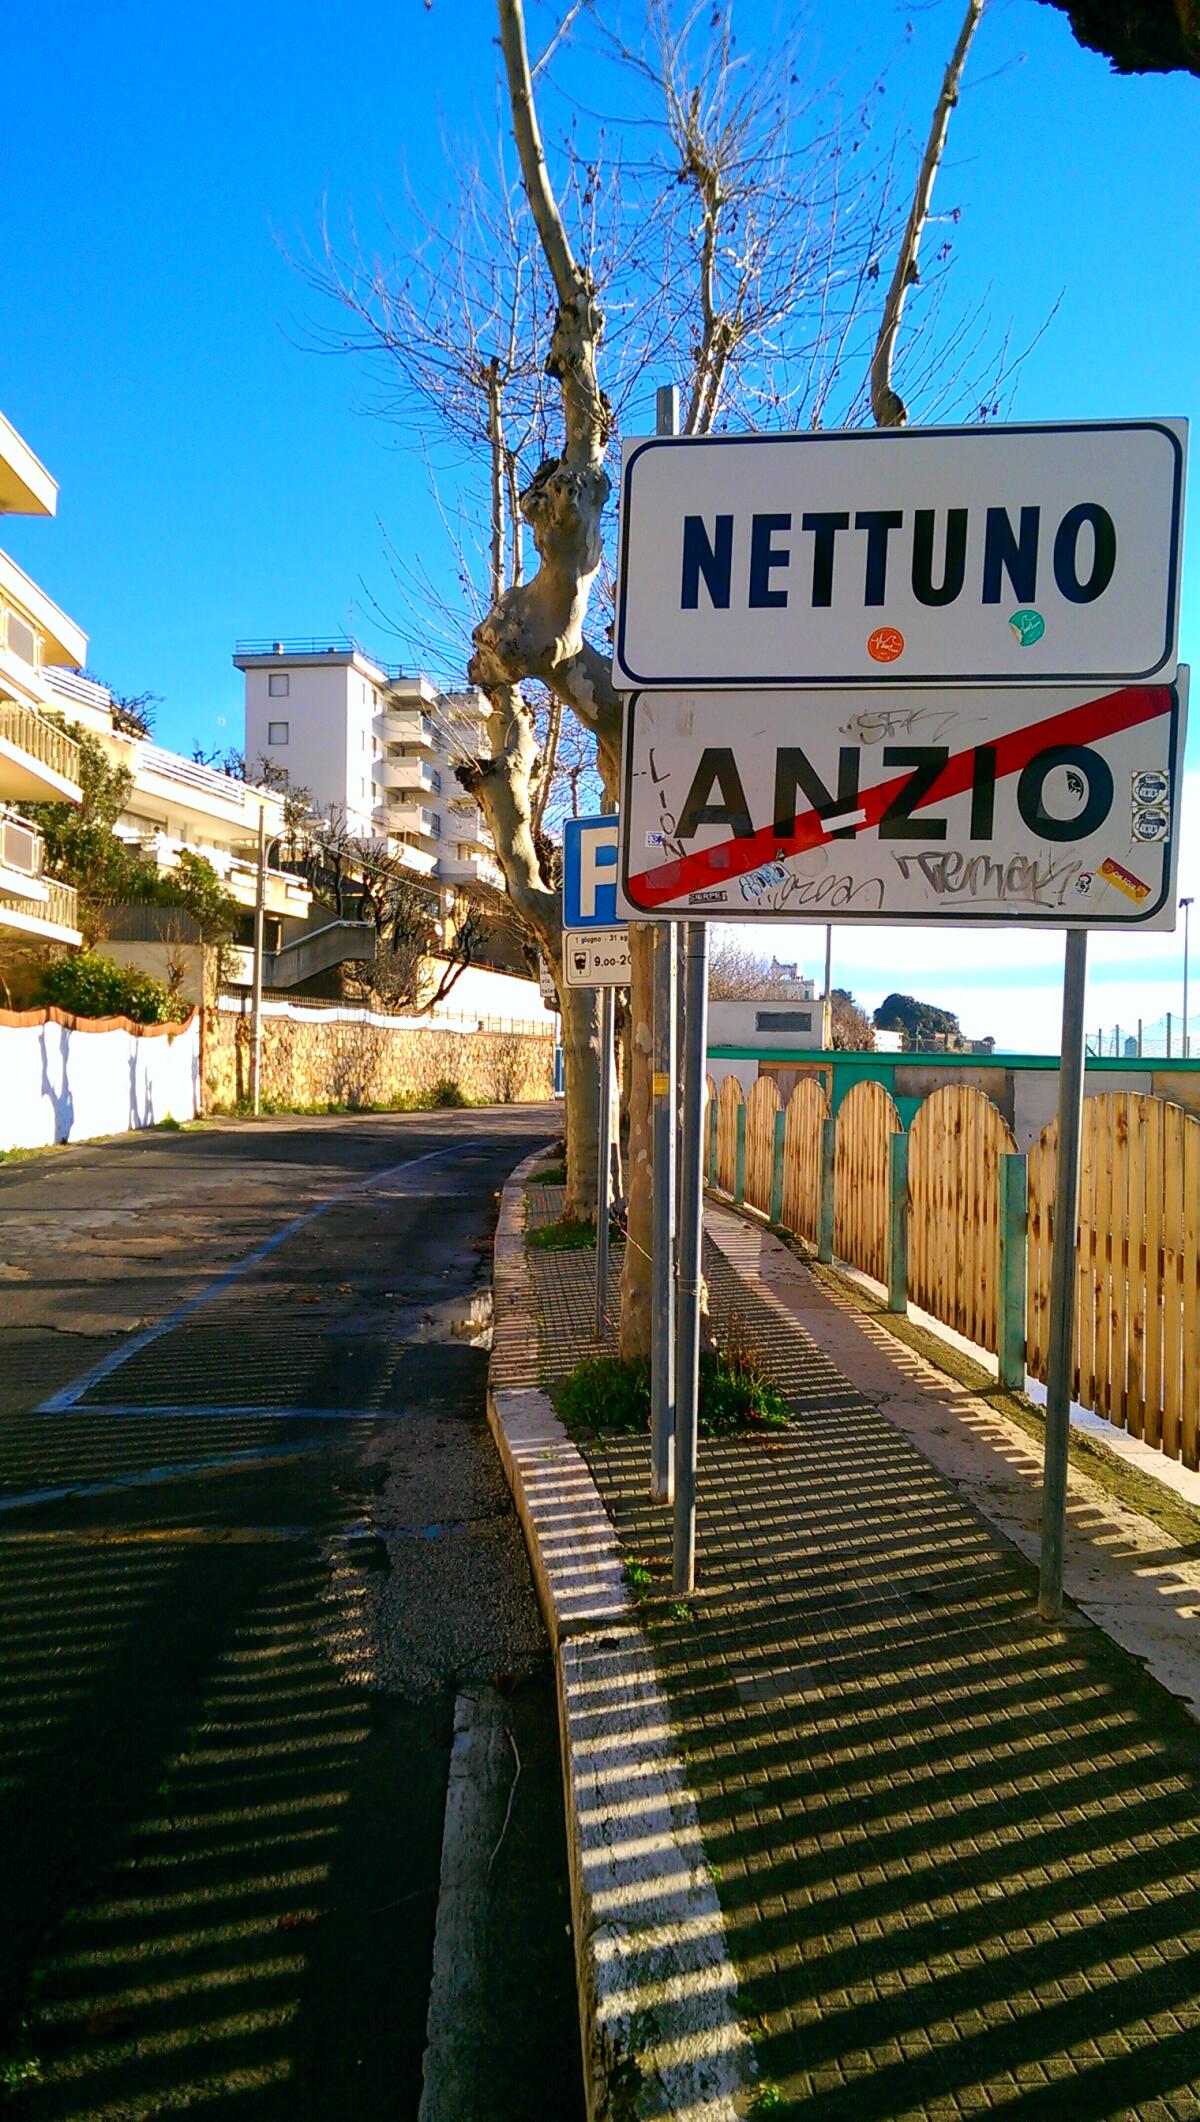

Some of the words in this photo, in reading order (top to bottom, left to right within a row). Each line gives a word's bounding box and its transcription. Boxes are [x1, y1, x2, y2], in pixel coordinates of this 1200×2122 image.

[680, 502, 1117, 610] NETTUNO
[674, 743, 1115, 842] ANZIO
[580, 826, 618, 917] P
[581, 935, 602, 944] giugno
[609, 934, 617, 942] 31
[594, 954, 632, 967] 9.00-20
